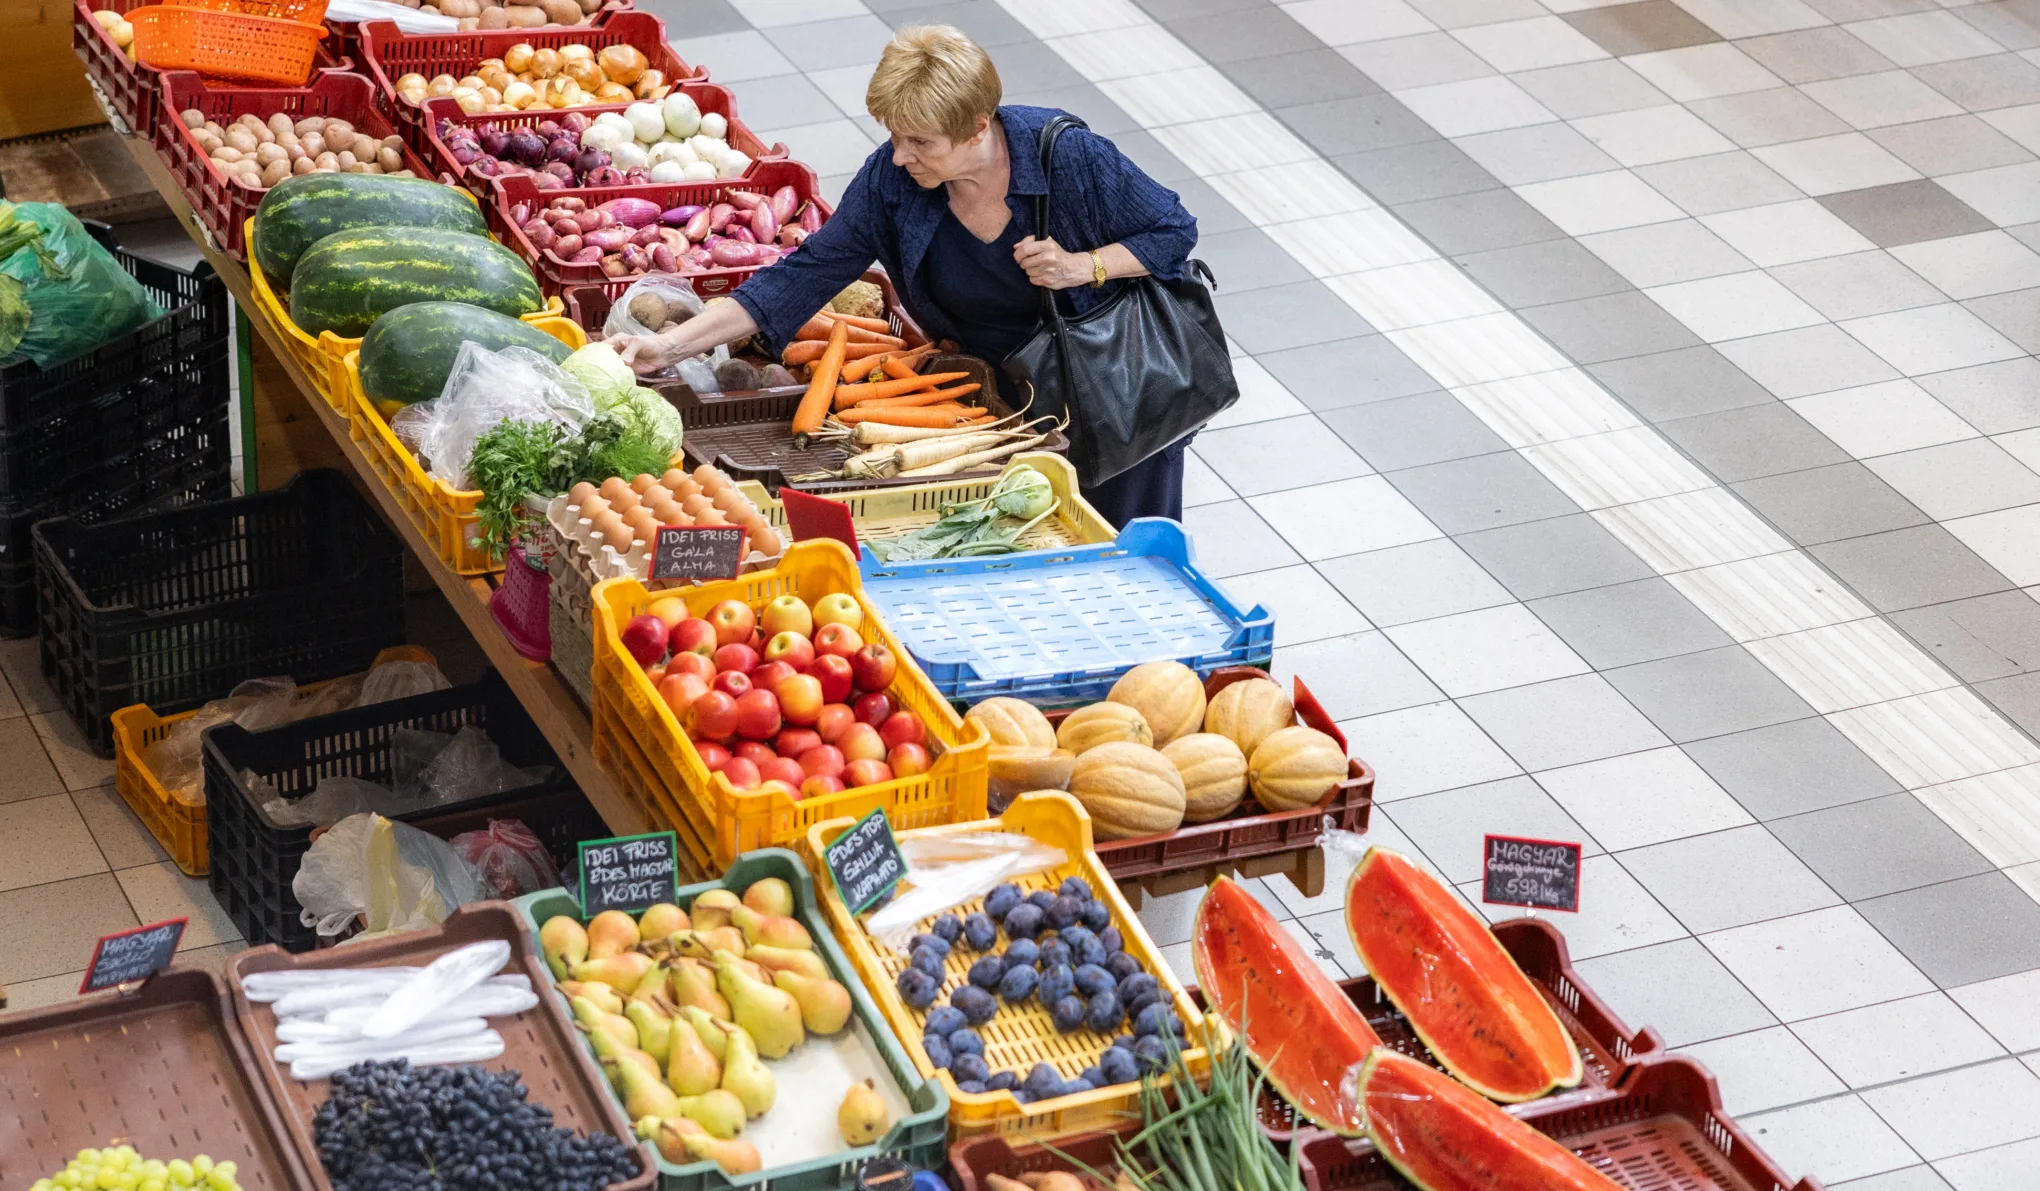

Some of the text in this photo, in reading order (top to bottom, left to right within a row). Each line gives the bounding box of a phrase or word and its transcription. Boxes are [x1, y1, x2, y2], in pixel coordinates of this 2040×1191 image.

[662, 530, 739, 545] IDEI FRISS
[670, 561, 716, 572] ALMA
[584, 847, 618, 867] IDEI
[1493, 839, 1575, 868] MAGYAR
[602, 879, 668, 905] KÖRTE
